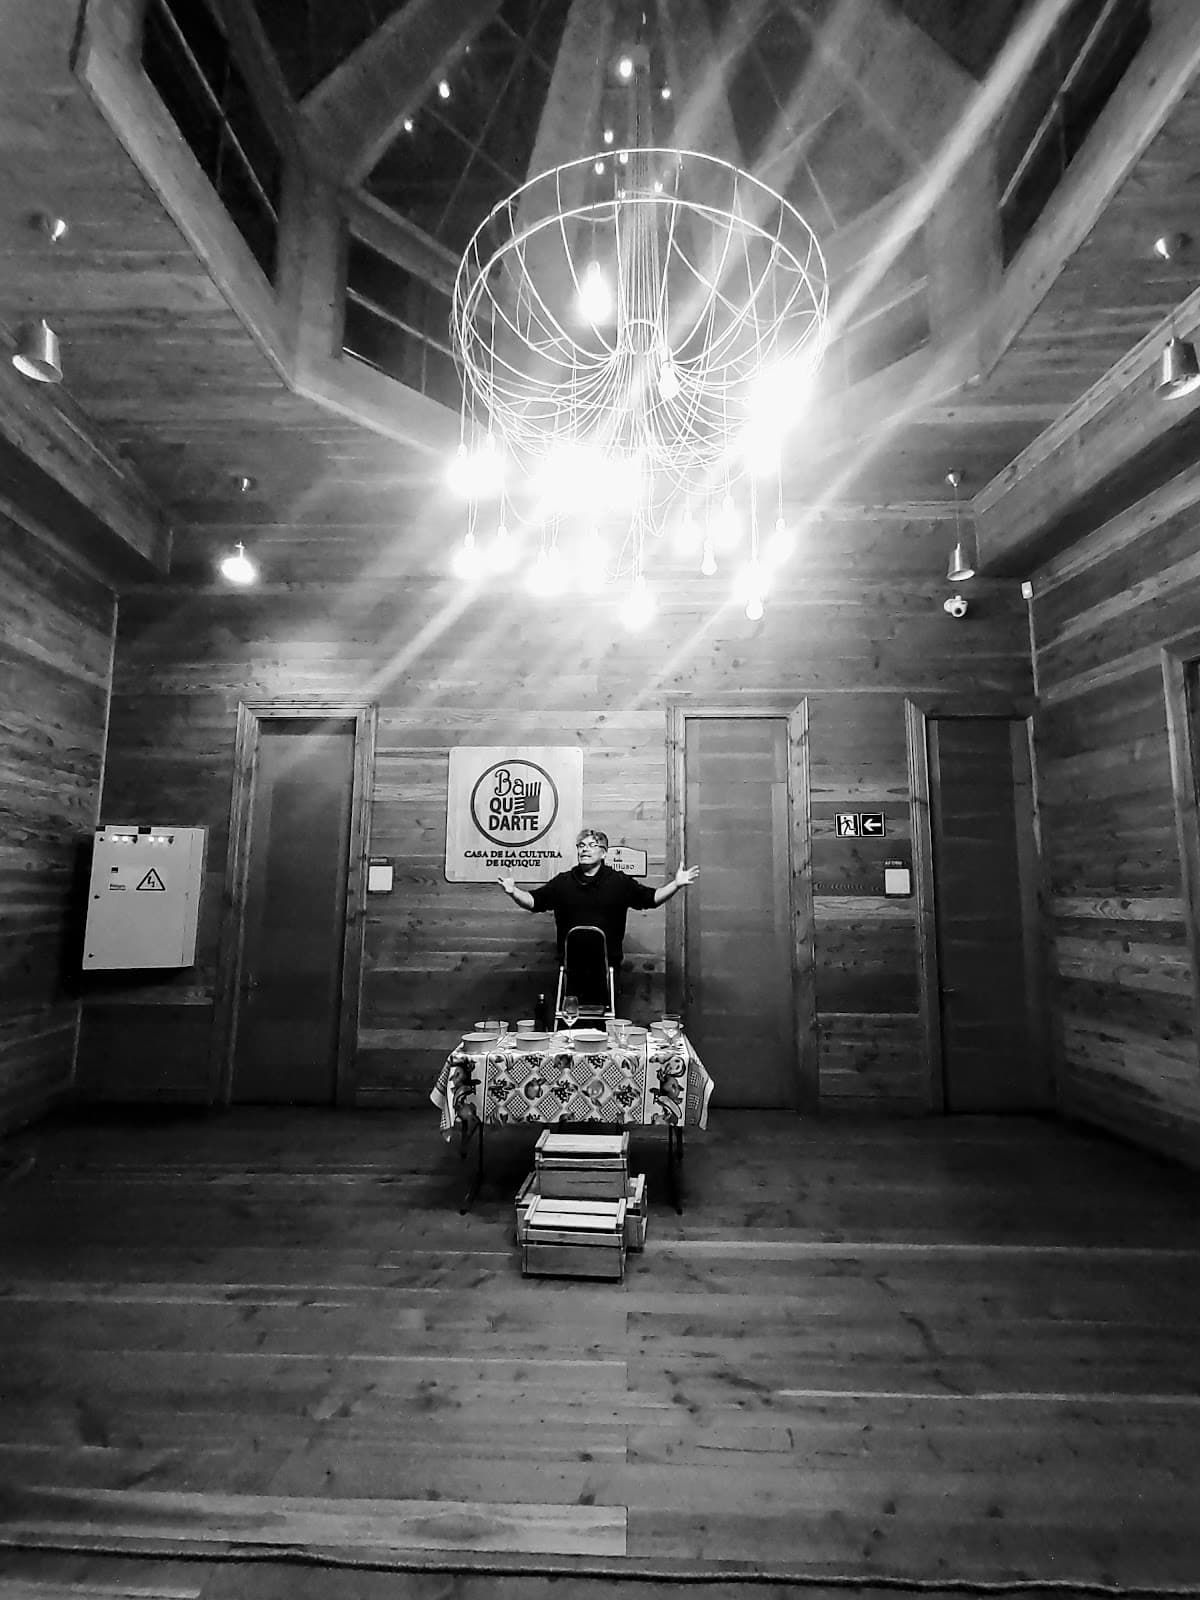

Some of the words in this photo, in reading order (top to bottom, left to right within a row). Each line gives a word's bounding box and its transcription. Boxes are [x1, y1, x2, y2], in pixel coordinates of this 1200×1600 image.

[494, 769, 525, 797] Ba
[489, 815, 538, 831] DARTE
[464, 850, 489, 858] CASA
[491, 850, 503, 858] DE
[505, 850, 517, 858] LA
[519, 850, 563, 858] CULTURA
[486, 859, 499, 867] DE
[500, 859, 541, 868] IQUIQUE
